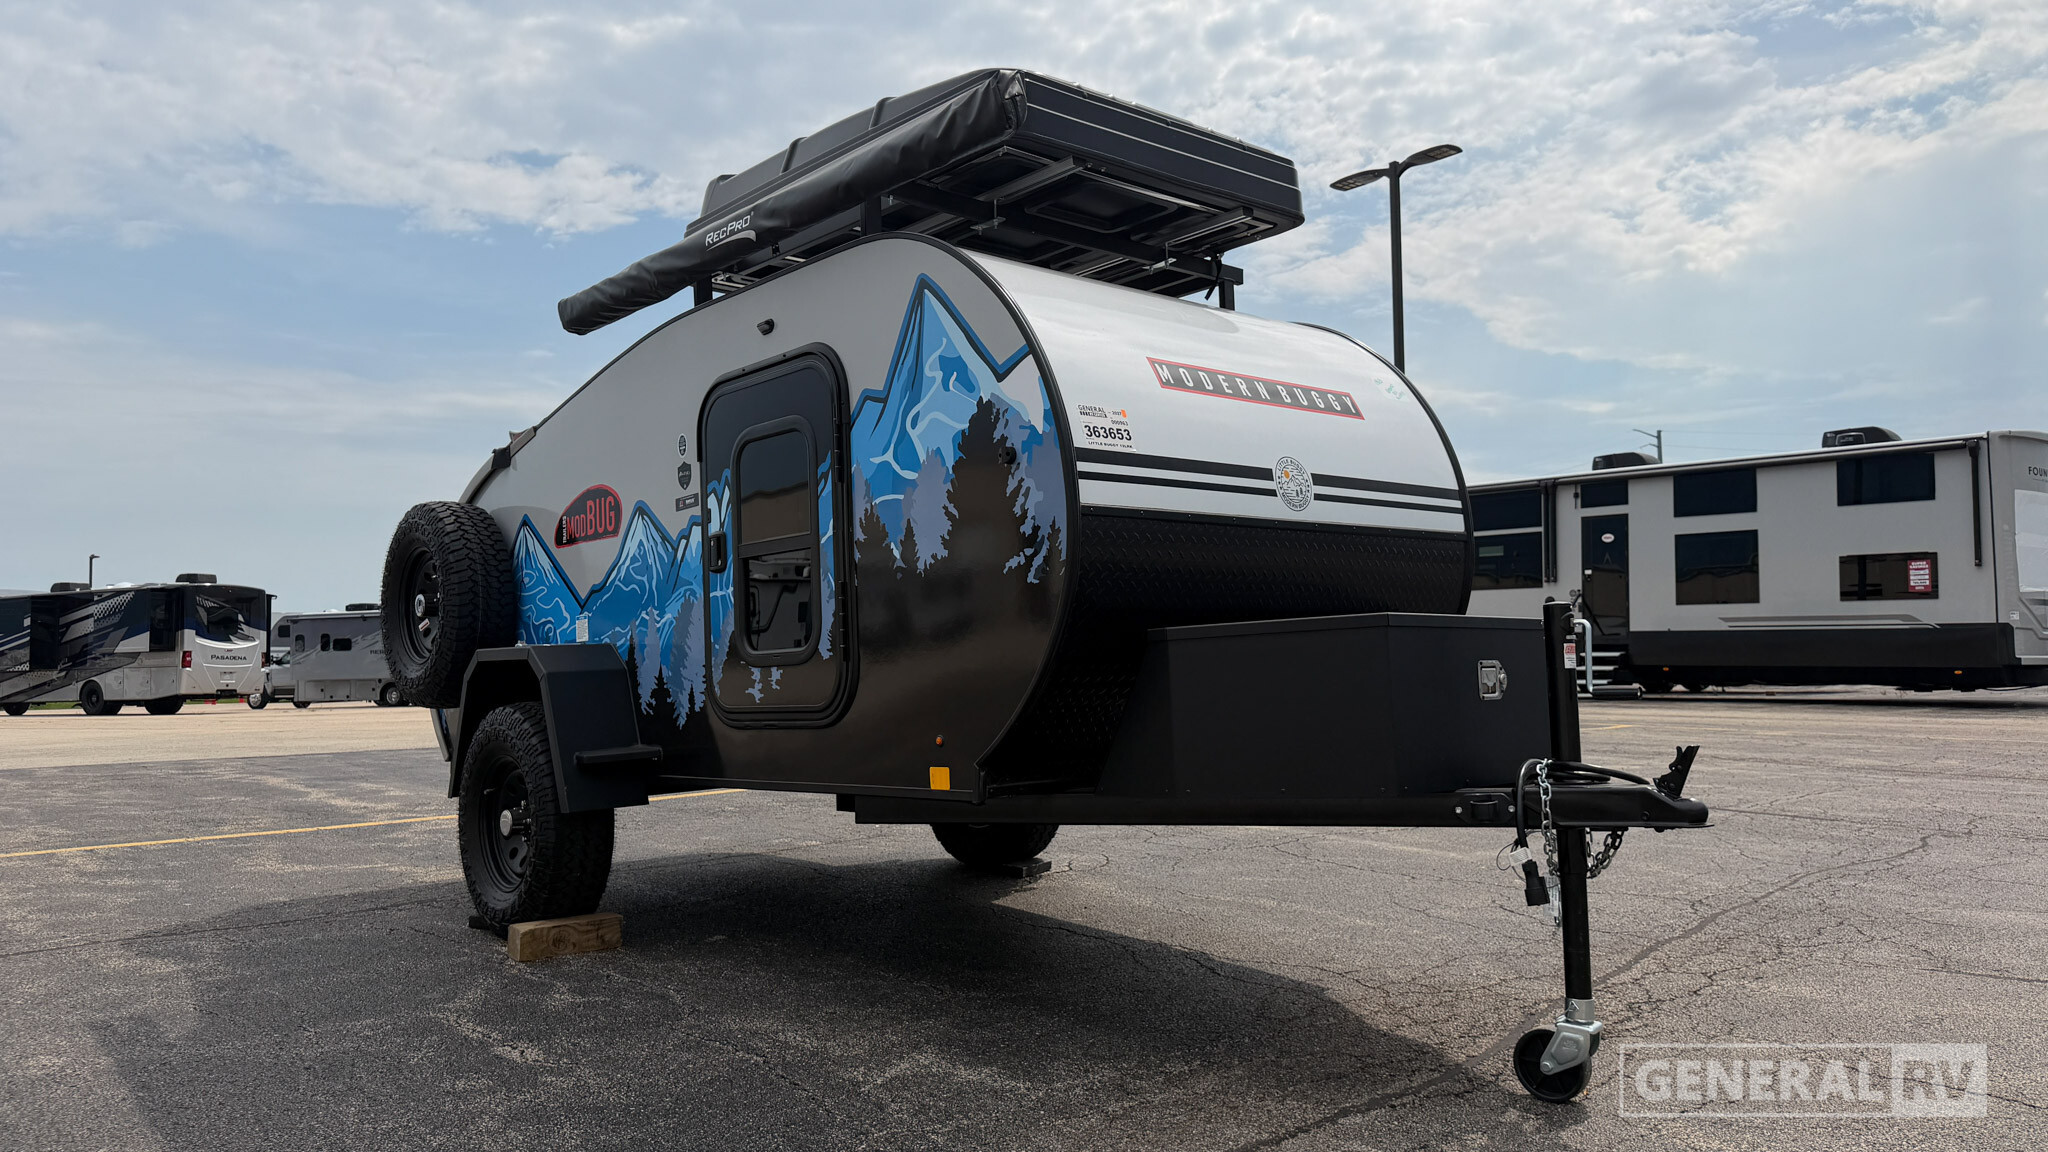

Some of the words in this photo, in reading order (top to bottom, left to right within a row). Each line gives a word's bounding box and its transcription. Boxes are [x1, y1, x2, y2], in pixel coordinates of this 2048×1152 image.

[1154, 363, 1271, 400] MODERN
[1276, 385, 1356, 414] BUGGY
[1078, 405, 1105, 413] GENERAL
[1084, 424, 1132, 441] 363653
